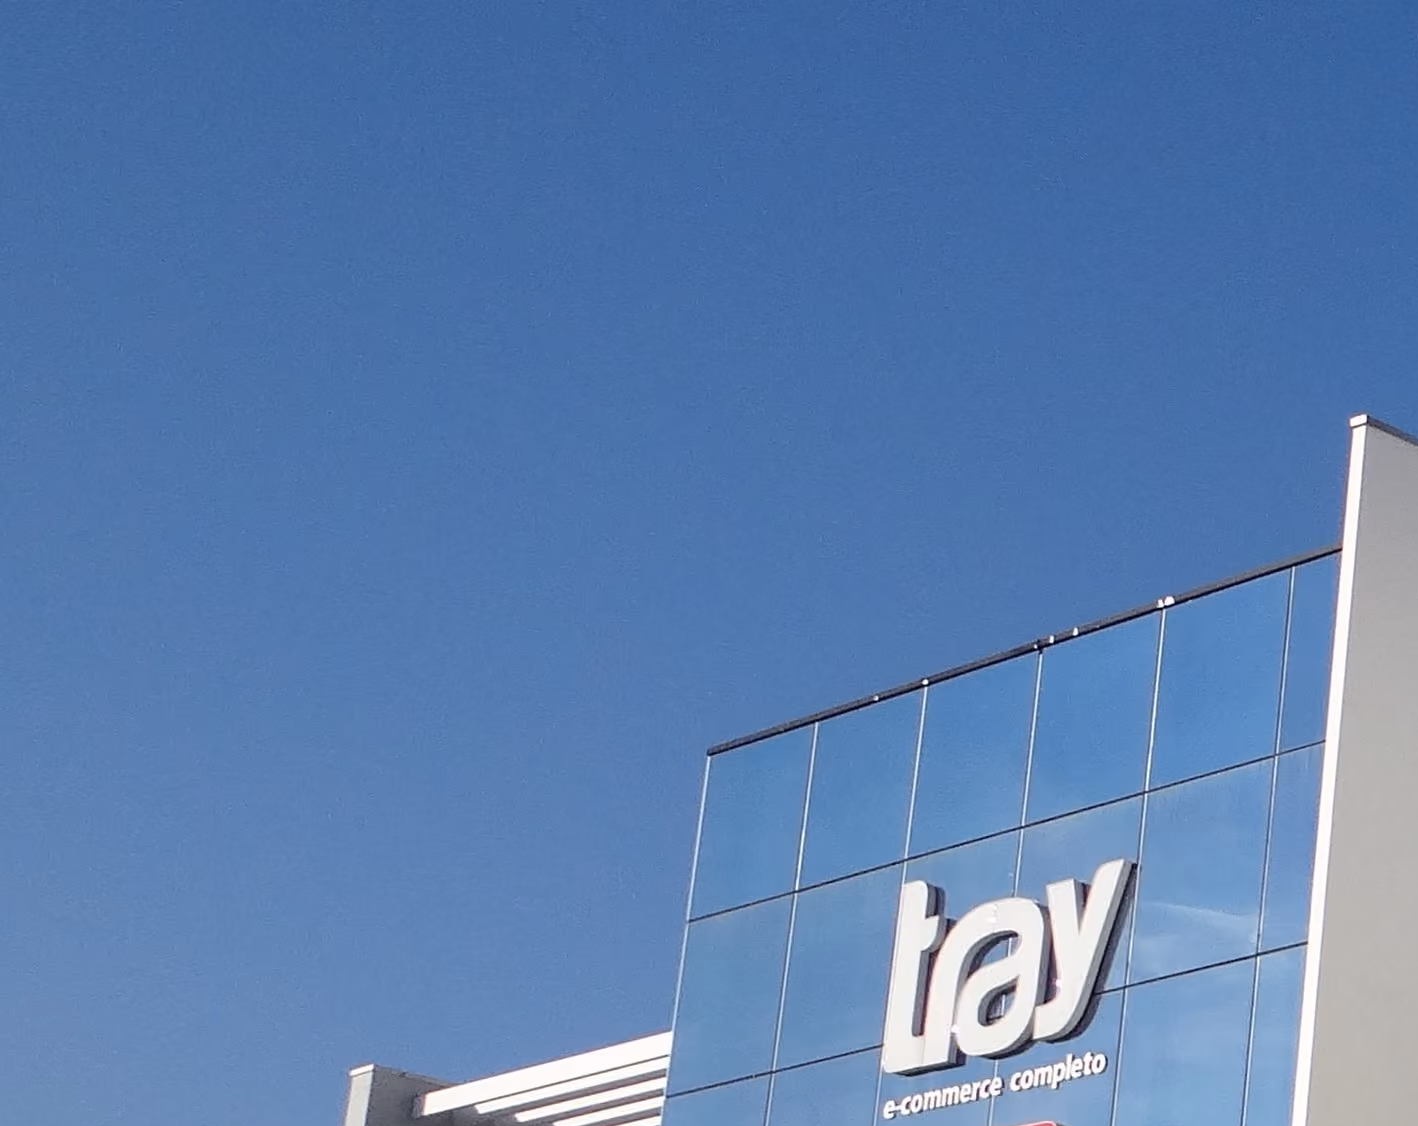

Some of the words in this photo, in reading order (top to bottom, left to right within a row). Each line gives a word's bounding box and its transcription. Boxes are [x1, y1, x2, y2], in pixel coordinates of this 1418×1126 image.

[883, 857, 1132, 1075] tray
[882, 1076, 1004, 1120] e-commerce
[1010, 1052, 1107, 1089] completo
